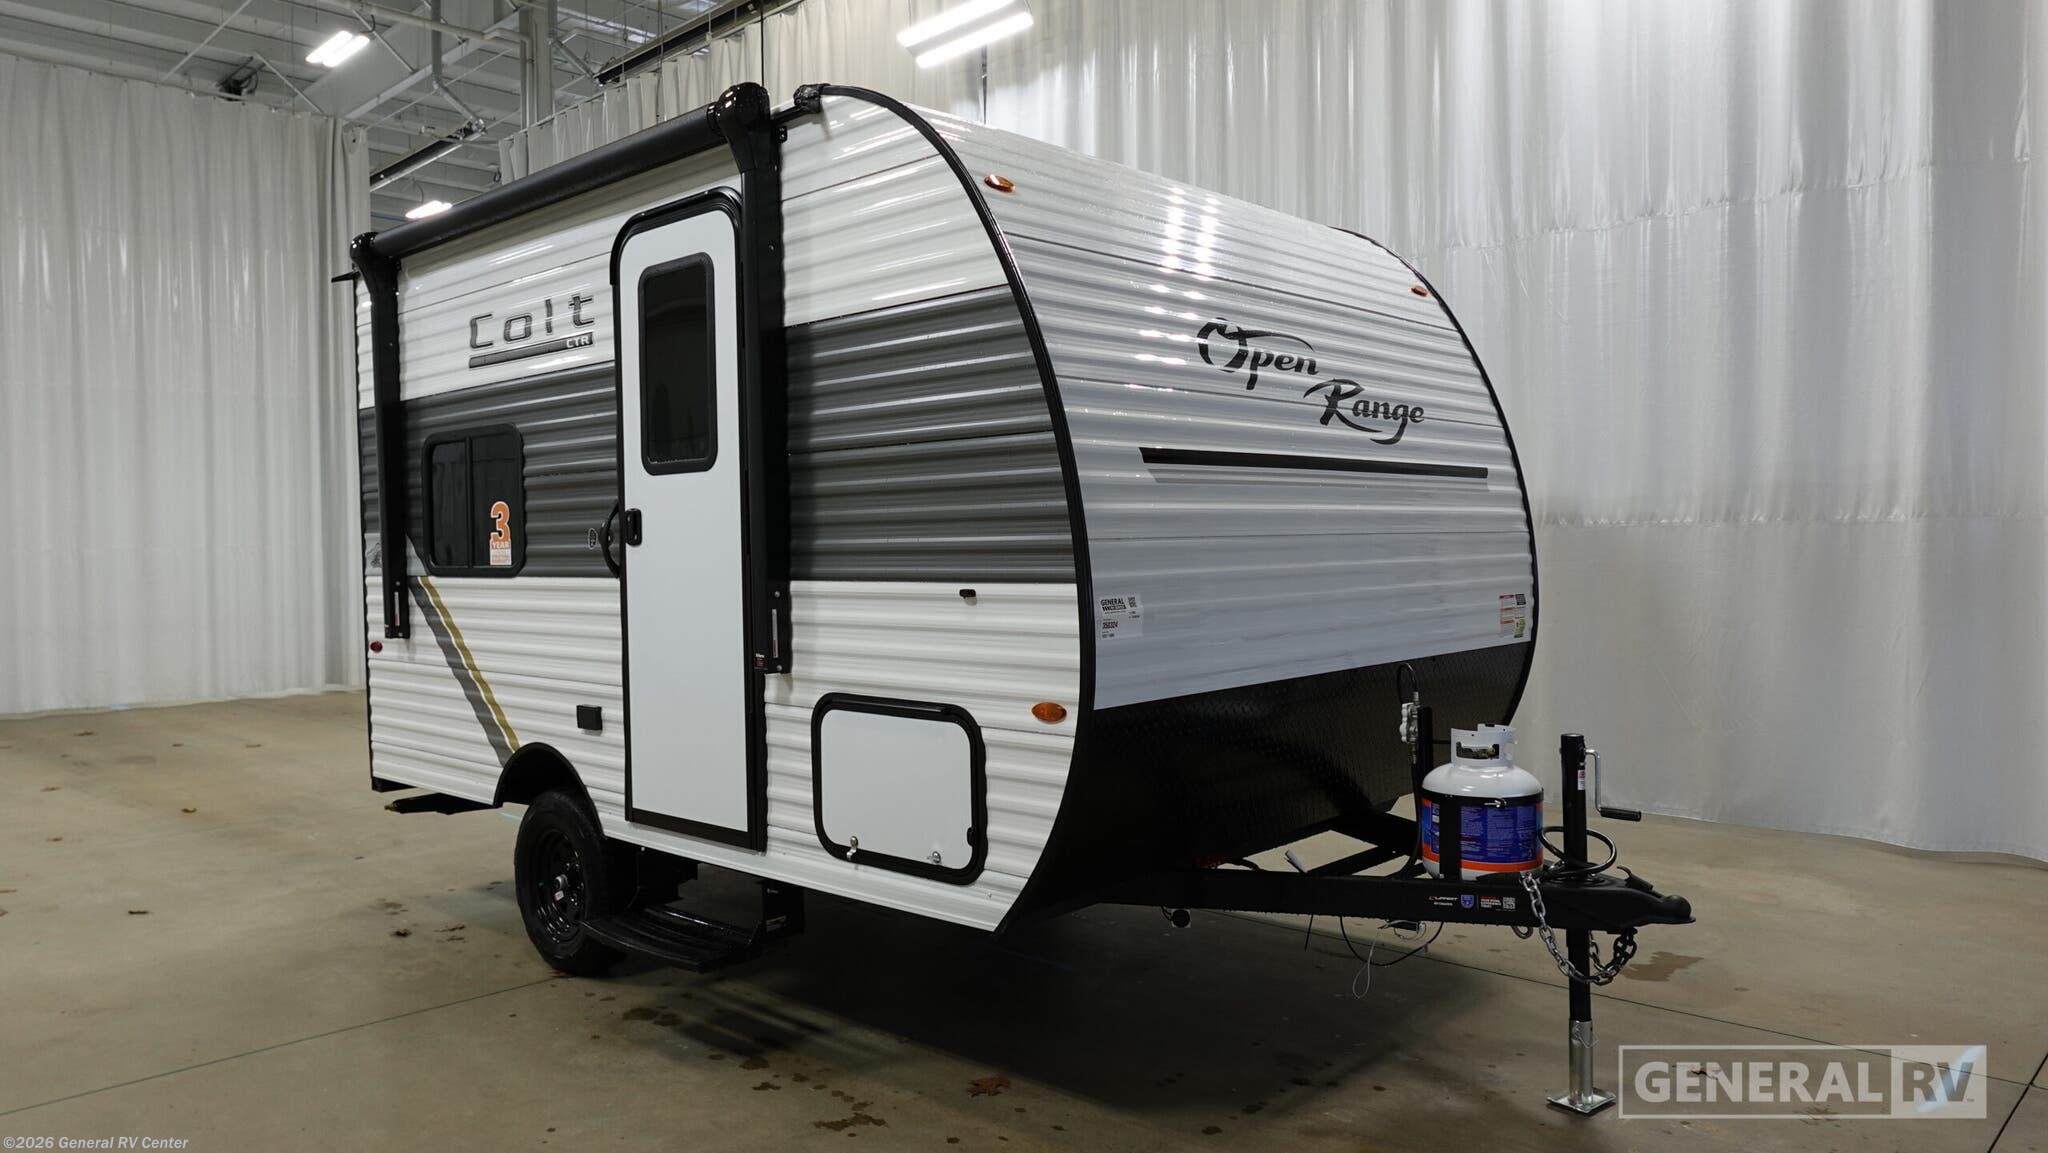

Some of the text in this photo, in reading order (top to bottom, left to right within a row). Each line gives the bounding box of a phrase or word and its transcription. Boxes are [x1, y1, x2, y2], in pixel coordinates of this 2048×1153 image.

[469, 294, 595, 349] Colt
[565, 335, 590, 349] CTR
[1197, 317, 1319, 390] Open
[1303, 378, 1424, 445] Range
[490, 501, 510, 542] 3
[491, 541, 510, 549] YEAR
[1100, 598, 1124, 606] GENERAL
